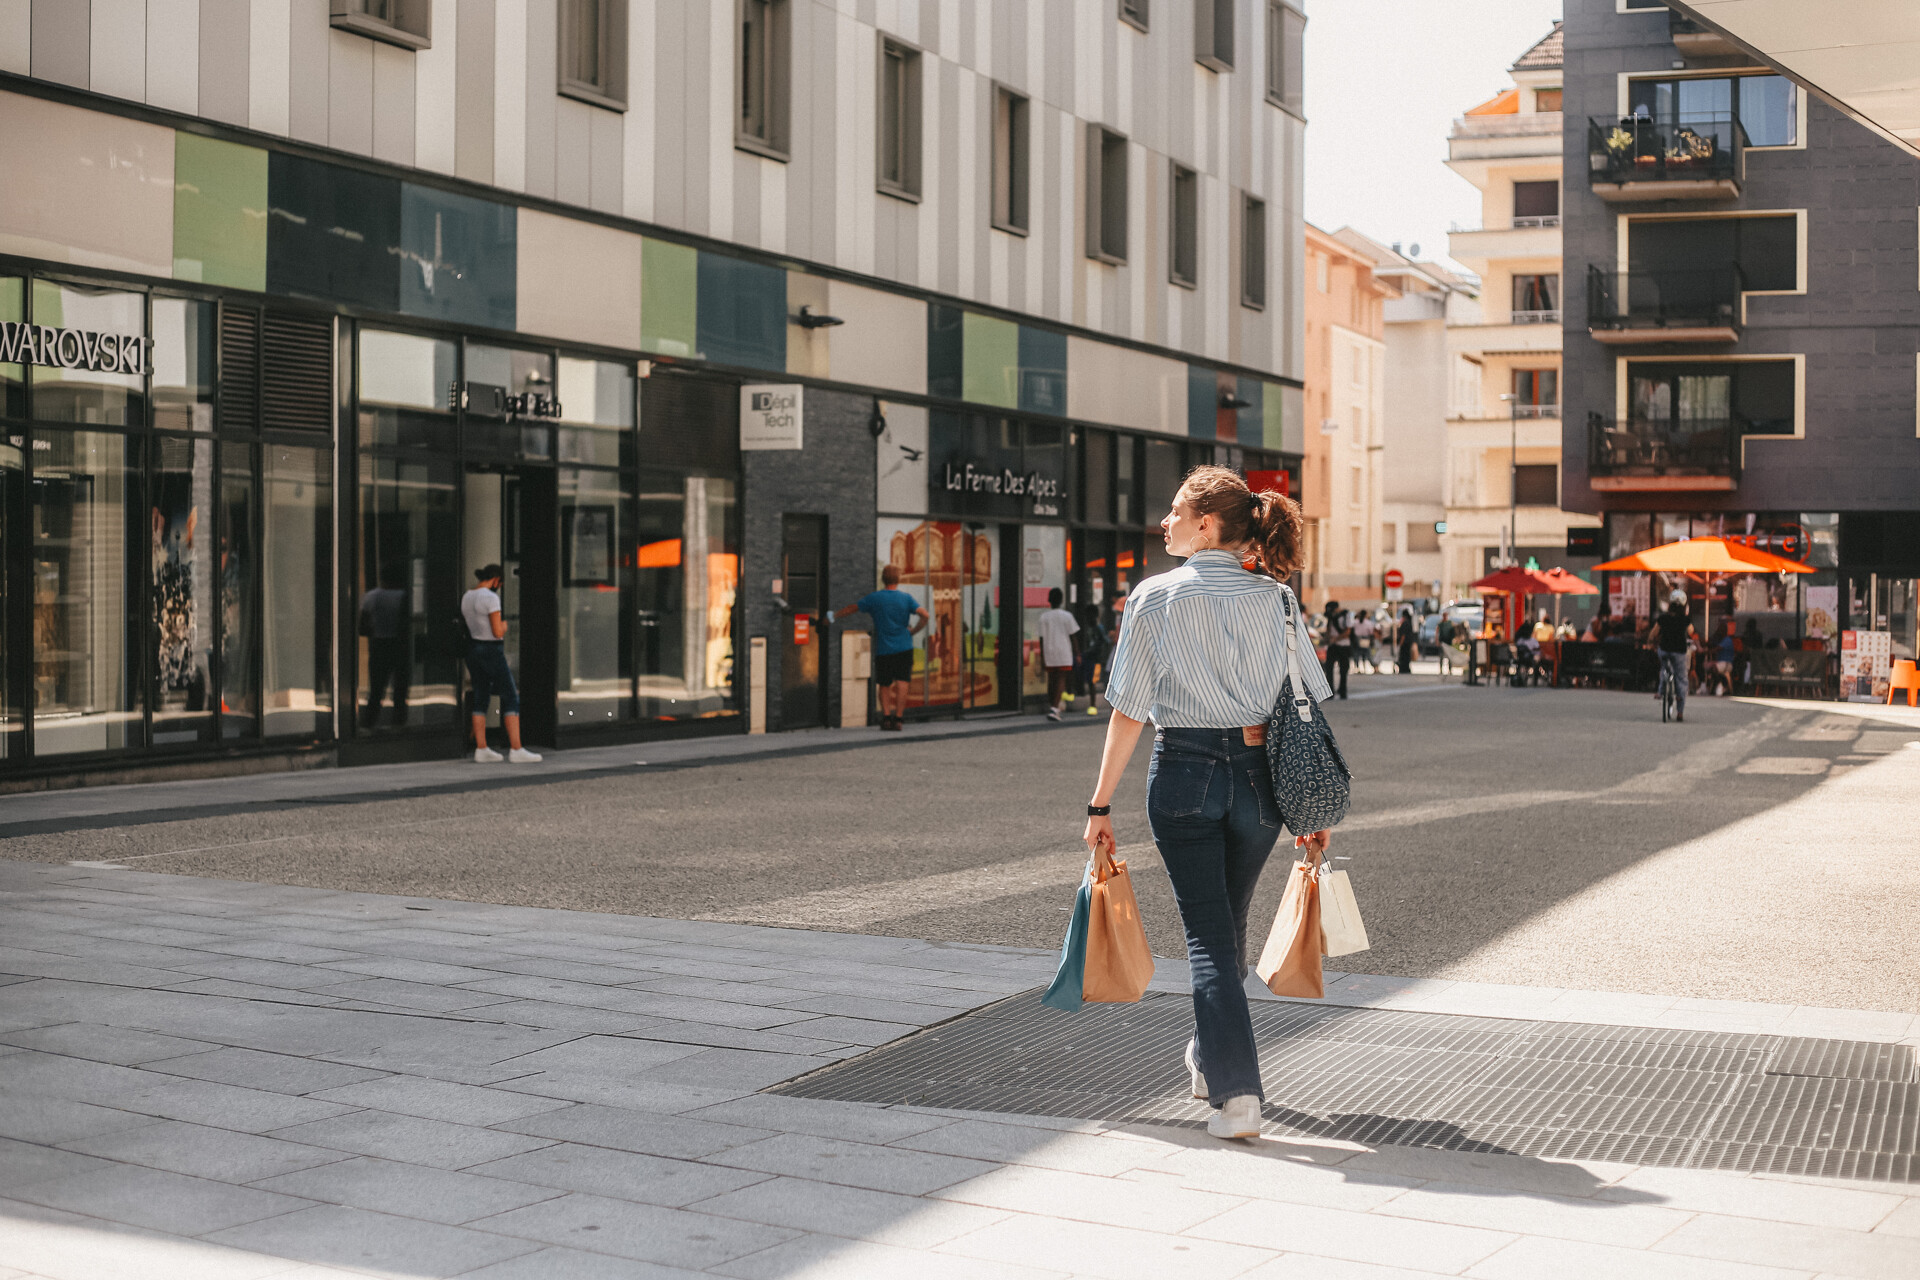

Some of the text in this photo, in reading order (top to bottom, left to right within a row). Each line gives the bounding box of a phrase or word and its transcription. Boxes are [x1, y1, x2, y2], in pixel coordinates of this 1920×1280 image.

[762, 412, 795, 428] Tech
[947, 463, 1057, 505] La Ferme Des Alpes
